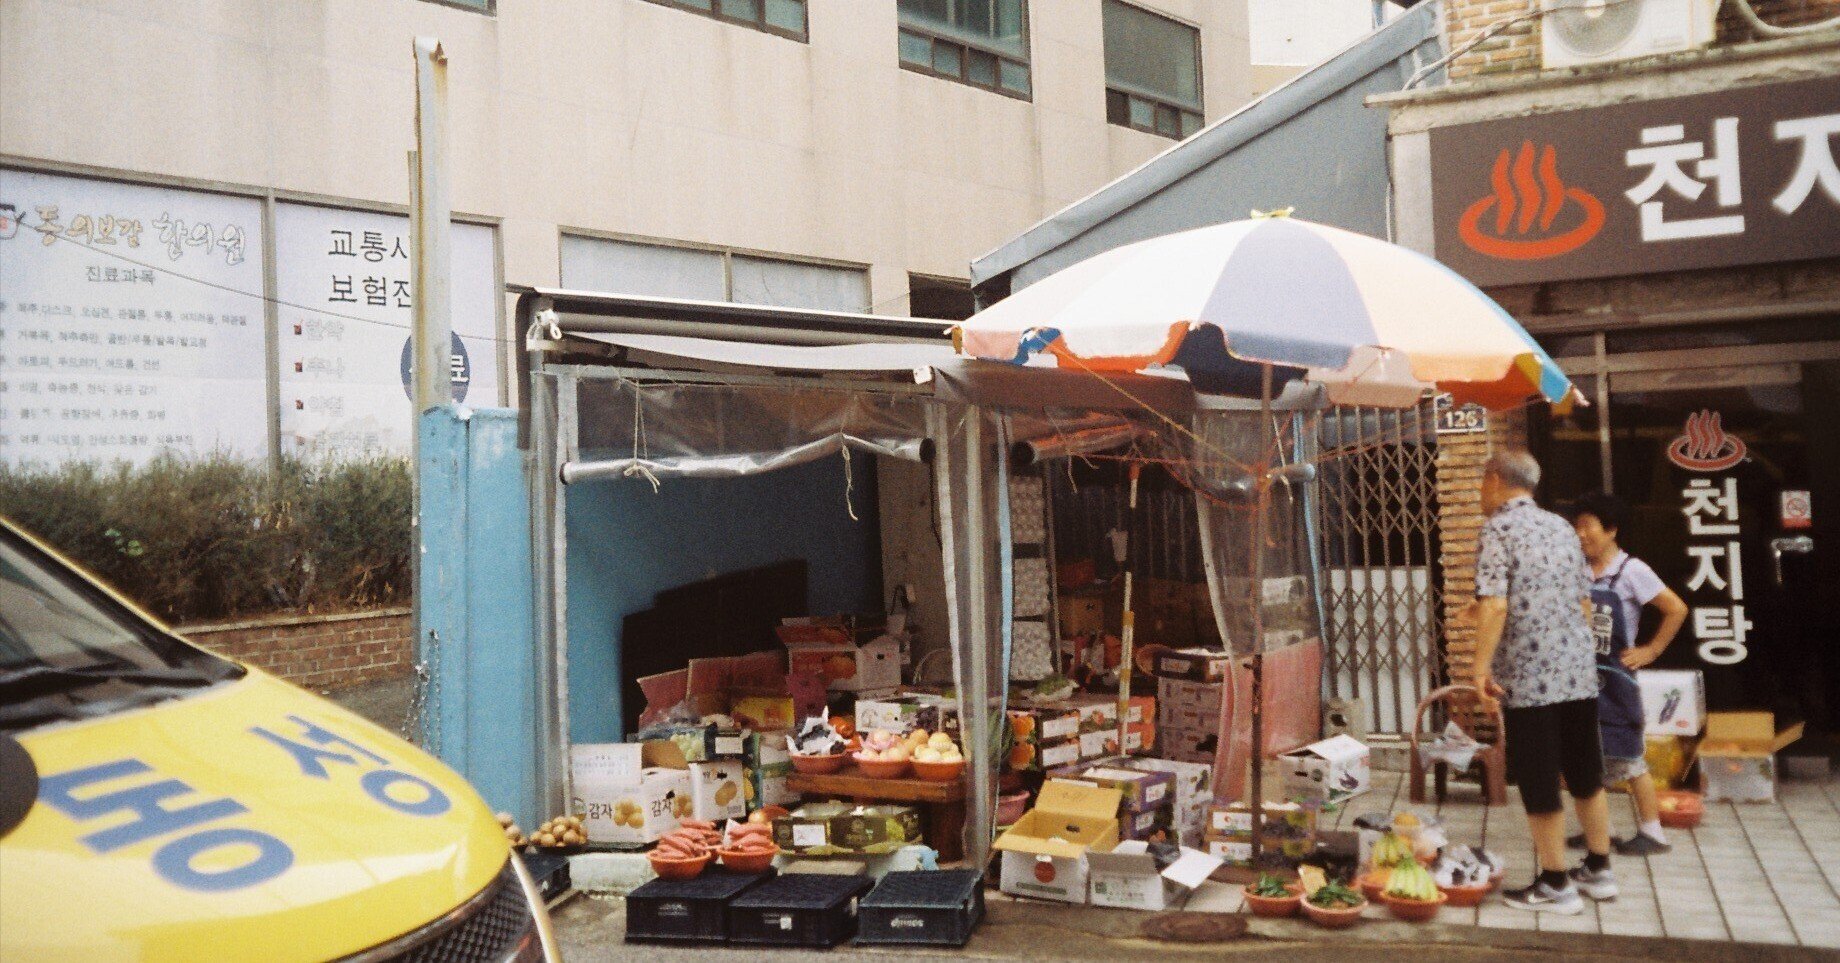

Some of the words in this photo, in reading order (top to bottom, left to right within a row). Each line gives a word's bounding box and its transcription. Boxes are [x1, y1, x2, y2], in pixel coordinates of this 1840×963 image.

[34, 204, 144, 248] 동의보감
[152, 211, 246, 266] 한의원
[86, 265, 156, 285] 진료과목
[1445, 410, 1478, 428] 126
[1680, 476, 1754, 666] 천지탕
[589, 802, 613, 820] 감자
[650, 798, 672, 818] 감자
